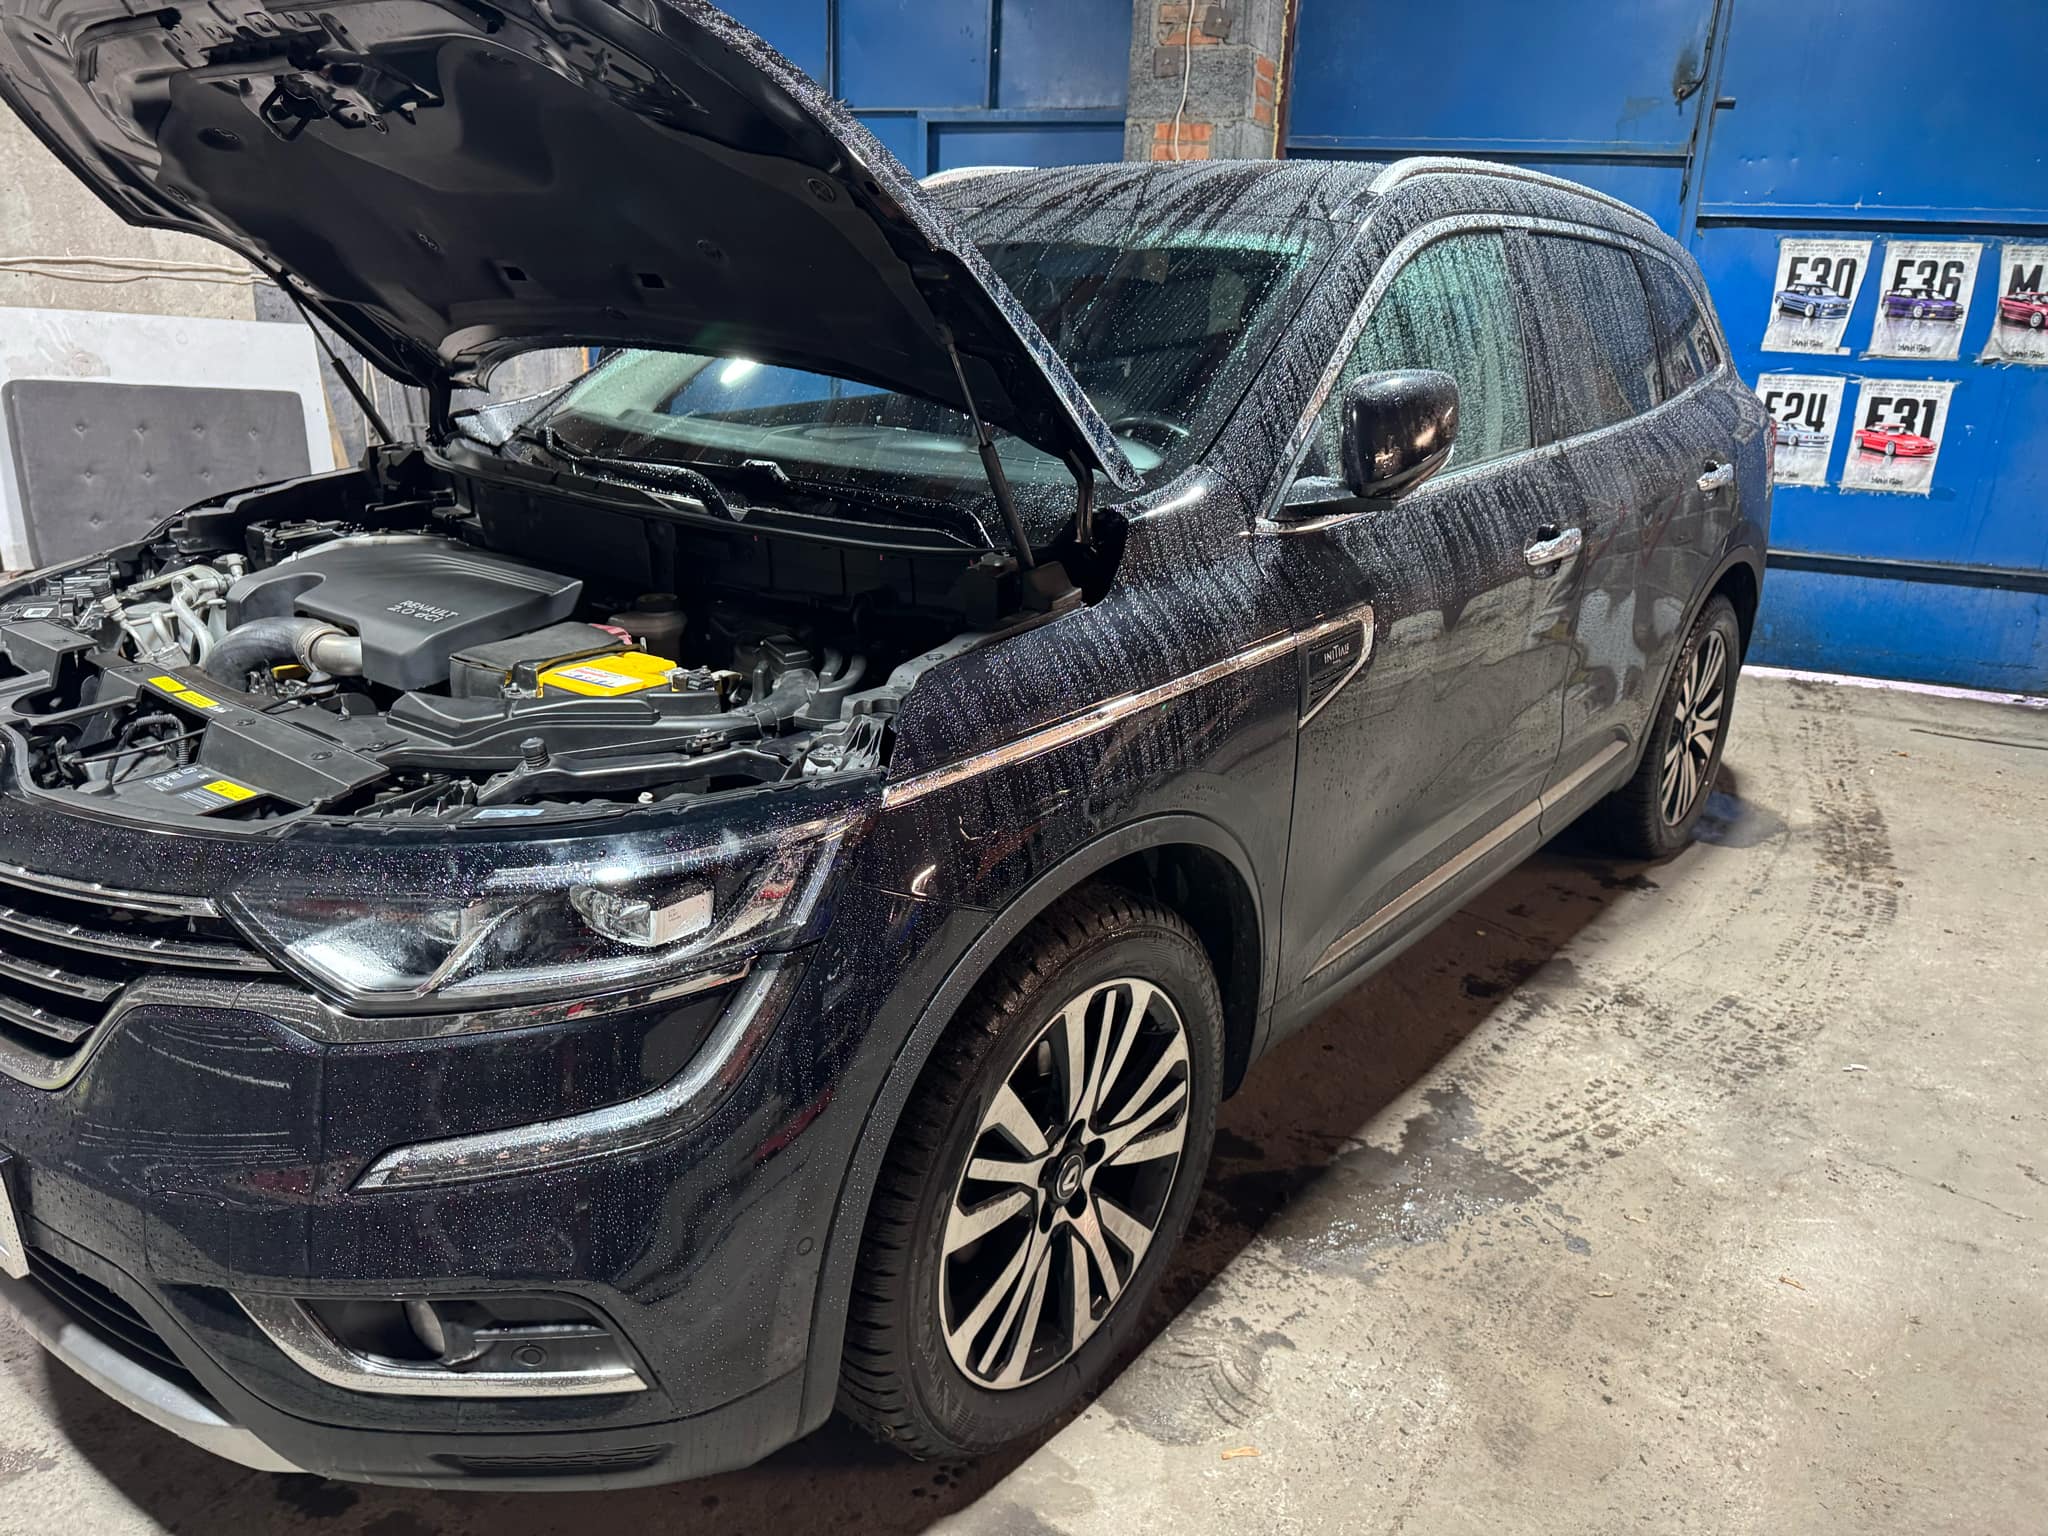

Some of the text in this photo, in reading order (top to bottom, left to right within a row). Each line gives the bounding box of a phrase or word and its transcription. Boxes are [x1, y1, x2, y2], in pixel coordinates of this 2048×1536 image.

[1787, 256, 1857, 299] E30
[1892, 259, 1964, 302] E36
[1765, 391, 1828, 432] E24
[1865, 396, 1938, 439] E31
[400, 600, 459, 618] RENAULT
